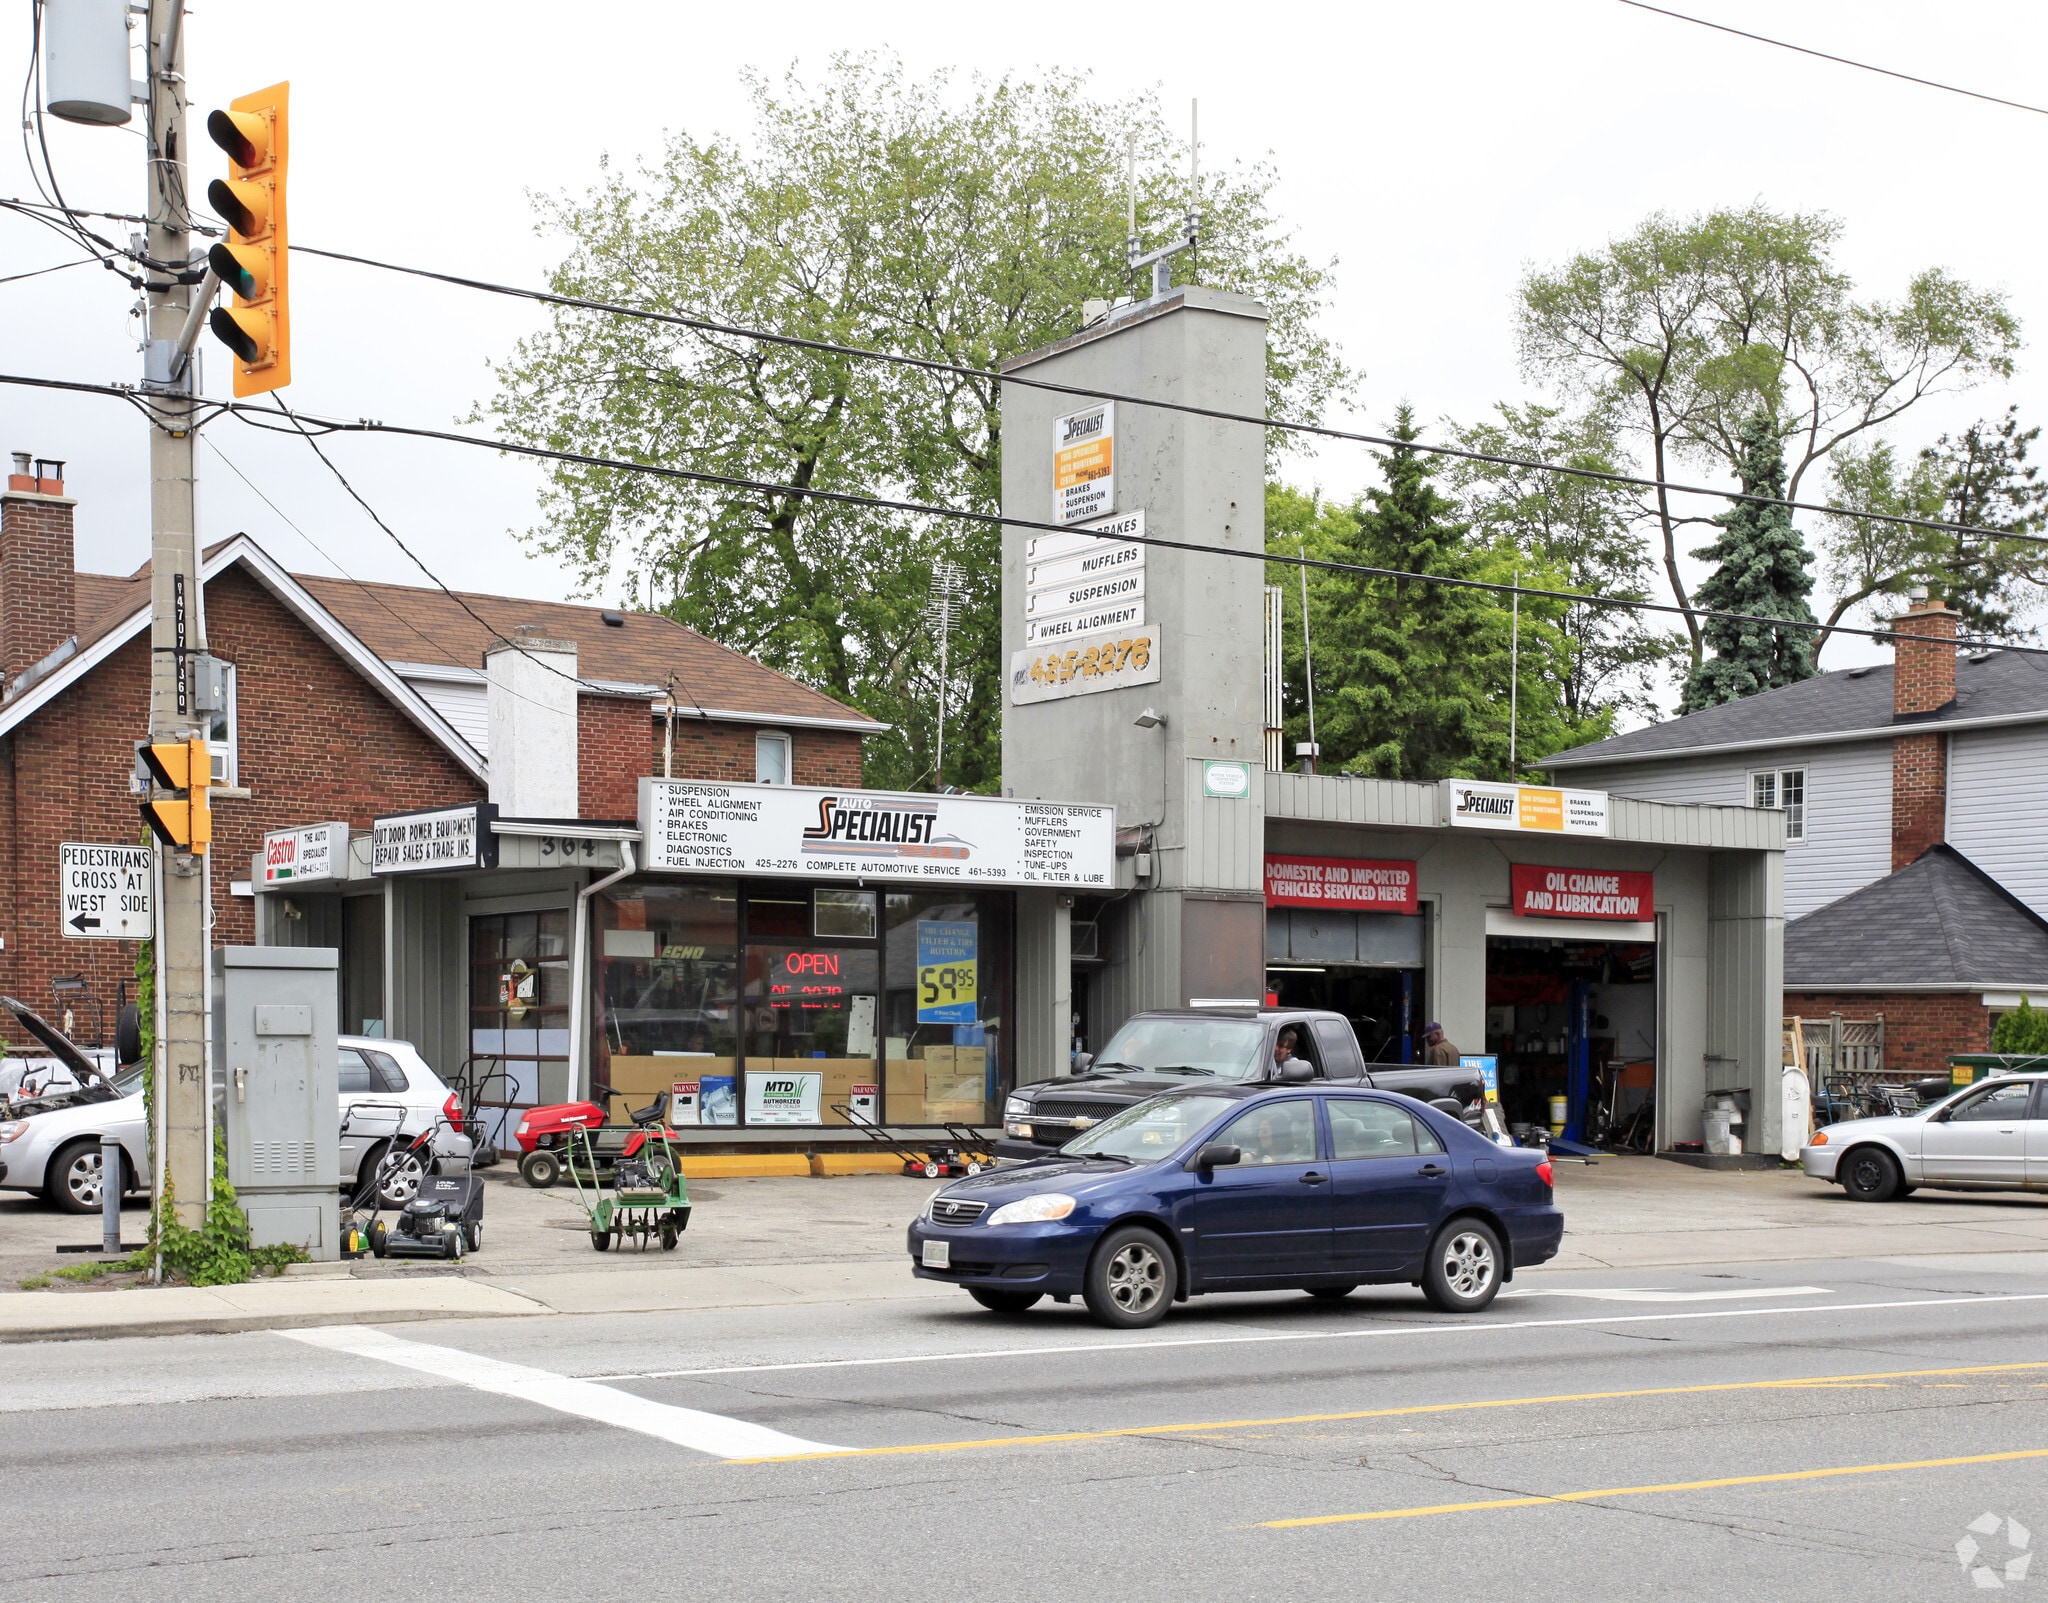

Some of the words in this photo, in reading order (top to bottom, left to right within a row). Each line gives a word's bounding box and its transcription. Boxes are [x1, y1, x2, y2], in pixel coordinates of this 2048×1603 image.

[1063, 413, 1104, 440] SPECIALIST
[1066, 483, 1091, 497] BRAKES
[1065, 490, 1106, 508] SUSPENSION
[1066, 504, 1098, 519] MUFFLERS
[1082, 548, 1138, 572] MUFFLERS
[1069, 578, 1138, 603] SUSPENSION
[1040, 622, 1073, 638] WHEEL
[1076, 608, 1137, 630] ALIGNMENT
[1030, 637, 1152, 687] 425-2276
[668, 785, 730, 797] SUSPENSION
[668, 797, 702, 807] WHEEL
[707, 799, 762, 811] ALIGNMENT
[841, 798, 872, 809] AUTO
[1456, 790, 1514, 815] SPECIALIST
[668, 808, 685, 818] AIR
[689, 809, 758, 822] CONDITIONING
[1025, 805, 1064, 816] EMISSION
[1067, 808, 1102, 818] SERVICE
[1570, 809, 1604, 817] SUSPENSION
[667, 819, 708, 830] BRAKES
[802, 796, 937, 844] SPECIALIST
[1024, 817, 1068, 827] MUFFLERS
[409, 822, 433, 841] POWER
[436, 817, 476, 837] EQUIPMENT
[1024, 828, 1082, 838] GOVERNMENT
[304, 832, 313, 844] THE
[315, 830, 327, 842] AUTO
[666, 831, 728, 843] ELECTRONIC
[1024, 838, 1058, 848] SAFETY
[267, 835, 297, 866] Castrol
[303, 846, 327, 860] SPECIALIST
[375, 846, 399, 864] REPAIR
[402, 842, 423, 861] SALES
[426, 842, 431, 859] &
[432, 840, 454, 859] TRADE
[457, 838, 470, 856] INS
[541, 836, 596, 858] 364
[666, 844, 732, 856] DIAGNOSTICS
[1024, 849, 1073, 859] INSPECTION
[63, 848, 149, 869] PEDESTRIANS
[666, 856, 690, 866] FUEL
[695, 858, 745, 868] INJECTION
[755, 858, 798, 869] 425-2276
[1025, 860, 1068, 870] TUNE-UPS
[806, 860, 856, 872] COMPLETE
[861, 863, 919, 874] AUTOMOTIVE
[923, 865, 960, 876] SERVICE
[968, 867, 1007, 877] 461-5393
[1266, 862, 1323, 882] DOMESTIC
[1324, 866, 1349, 883] AND
[1351, 868, 1410, 885] IMPORTED
[72, 871, 117, 890] CROSS
[127, 873, 143, 890] AT
[1024, 871, 1040, 881] OIL,
[1043, 872, 1070, 881] FILTER
[1074, 873, 1080, 882] &
[1083, 874, 1104, 883] LUBE
[1546, 872, 1567, 891] OIL
[1568, 874, 1619, 894] CHANGE
[1270, 879, 1323, 898] VEHICLES
[1324, 882, 1376, 900] SERVICED
[1378, 885, 1407, 901] HERE
[67, 894, 106, 912] WEST
[120, 895, 148, 912] SIDE
[1524, 890, 1553, 910] AND
[1555, 893, 1639, 914] LUBRICATION
[940, 928, 971, 937] CHANGE
[921, 937, 949, 945] FILTER
[957, 938, 975, 947] TIRE
[661, 945, 706, 960] ECHO
[930, 947, 967, 956] ROTATION
[786, 952, 839, 975] OPEN
[921, 967, 957, 1004] 59
[957, 968, 975, 987] 95
[1463, 1060, 1482, 1069] TIRE
[674, 1084, 699, 1093] WARNING
[765, 1081, 794, 1092] MTD
[853, 1086, 877, 1094] WARNING
